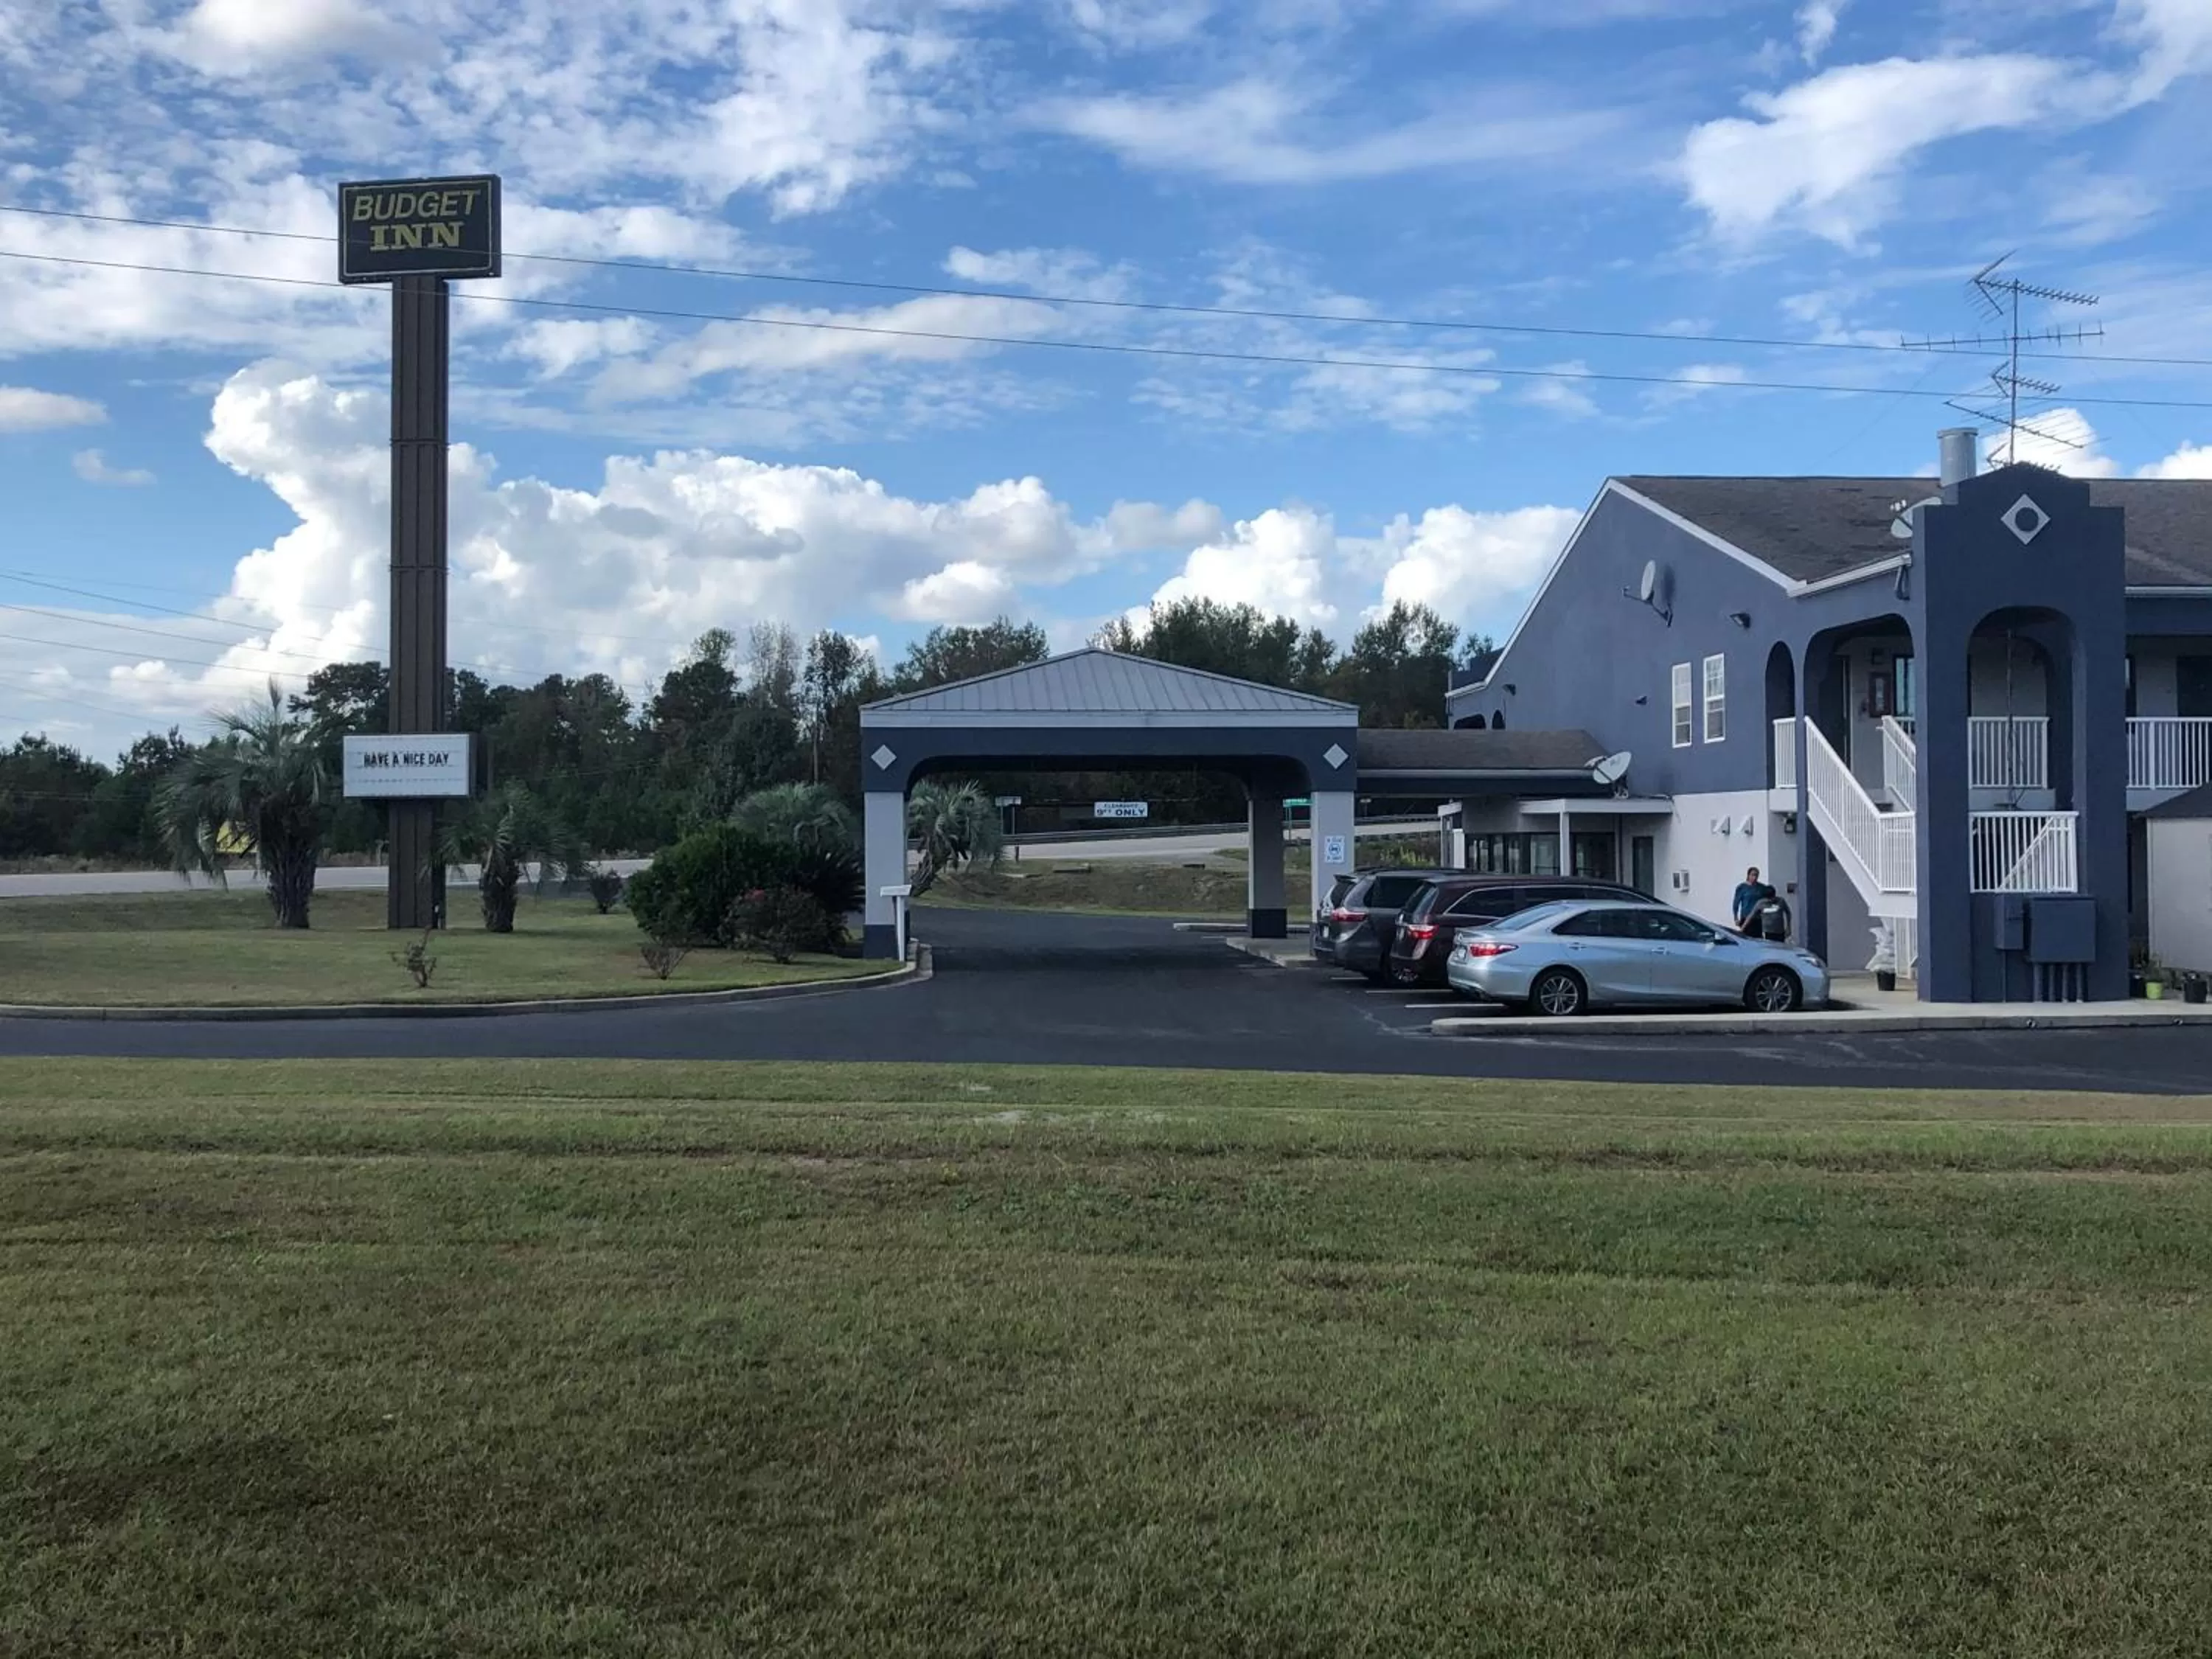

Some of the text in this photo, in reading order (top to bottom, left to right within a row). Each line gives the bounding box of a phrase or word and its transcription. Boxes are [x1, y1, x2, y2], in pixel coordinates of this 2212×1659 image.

[352, 189, 481, 221] BUDGET
[370, 221, 464, 251] INN
[364, 752, 448, 767] HAVE A NICE DAY
